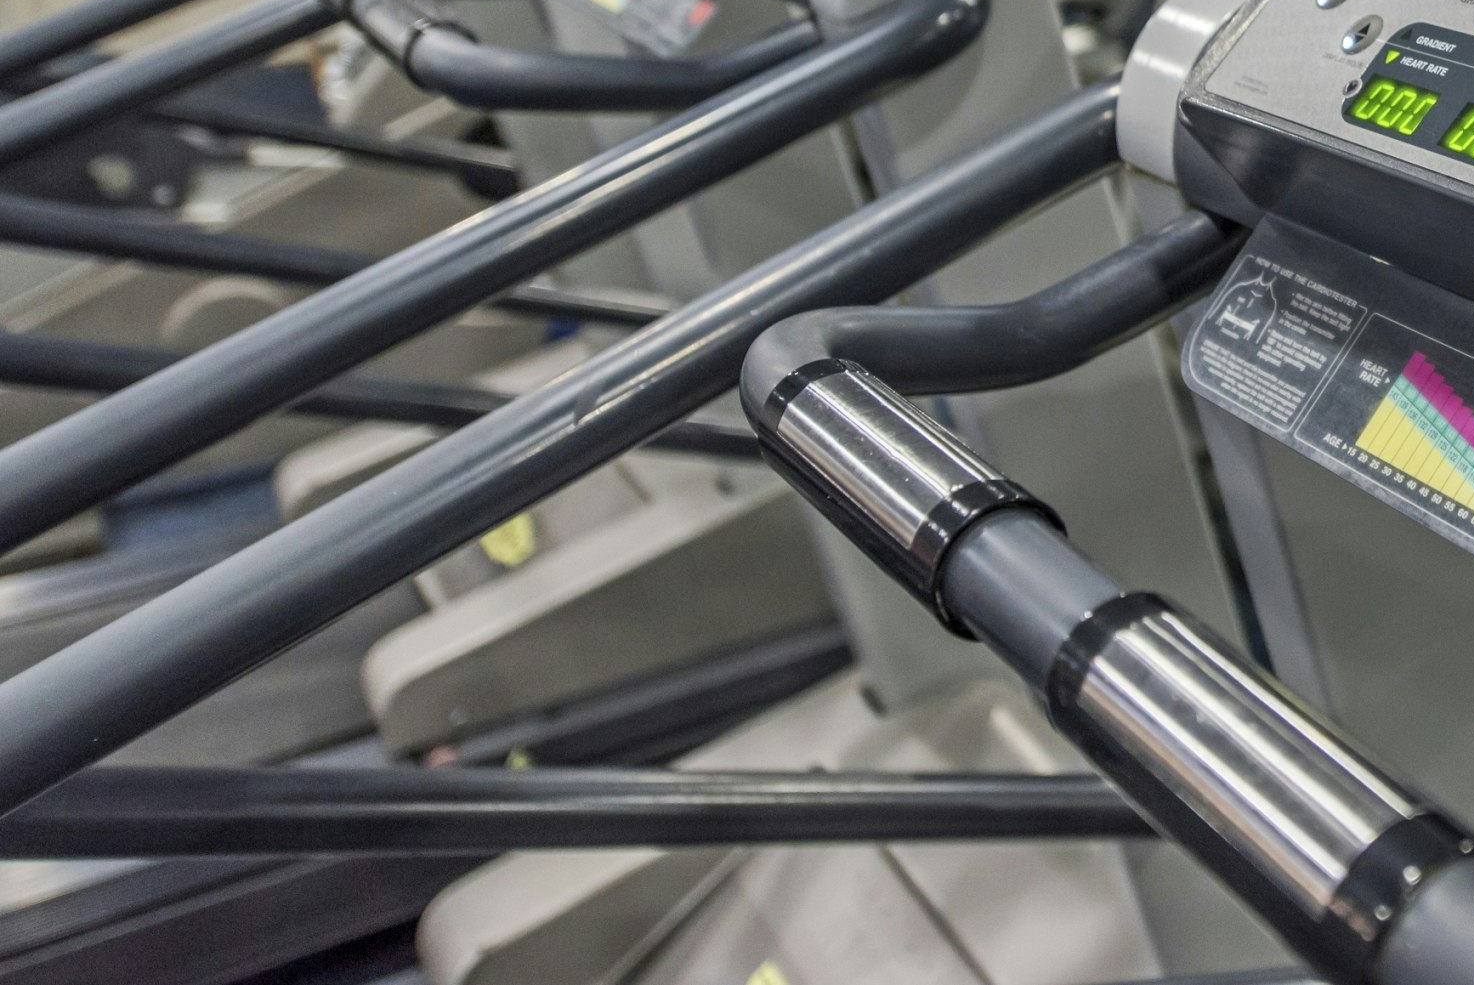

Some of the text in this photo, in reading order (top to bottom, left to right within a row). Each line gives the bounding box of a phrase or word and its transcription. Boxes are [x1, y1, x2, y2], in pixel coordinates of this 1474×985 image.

[1416, 36, 1457, 53] GRADIENT
[1400, 56, 1449, 76] HEART RATE
[1360, 358, 1389, 377] HEART
[1359, 370, 1382, 387] RATE
[1323, 433, 1343, 449] AGE
[1347, 446, 1356, 457] 15
[1358, 452, 1369, 463] 20
[1369, 458, 1380, 470] 25
[1381, 465, 1393, 476] 30
[1393, 471, 1405, 483] 35
[1406, 478, 1417, 490] 40
[1418, 486, 1430, 498] 45
[1431, 492, 1442, 505] 50
[1443, 499, 1456, 512] 55
[1457, 507, 1469, 520] 60
